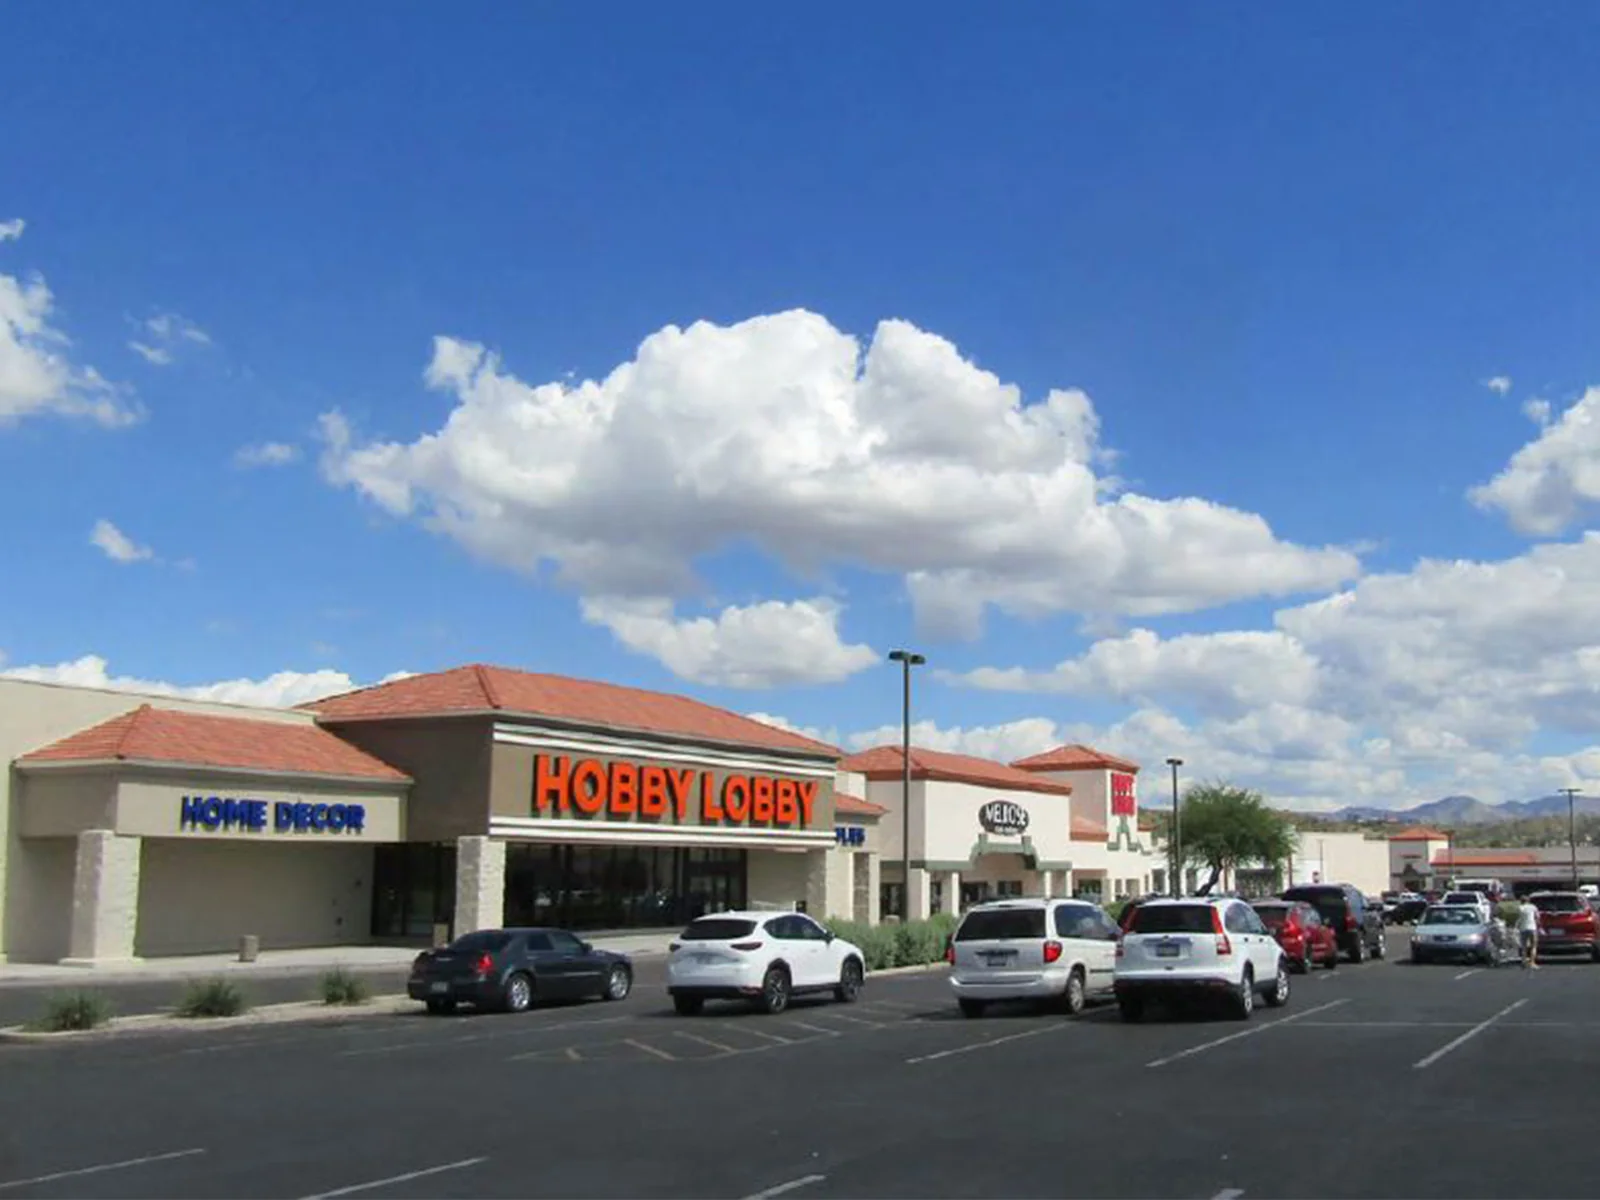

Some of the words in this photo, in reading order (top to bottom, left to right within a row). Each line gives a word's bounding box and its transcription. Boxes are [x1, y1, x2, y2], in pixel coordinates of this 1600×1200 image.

[182, 796, 268, 831] HOME
[275, 801, 366, 833] DECOR
[534, 754, 695, 820] HOBBY
[703, 771, 818, 829] LOBBY
